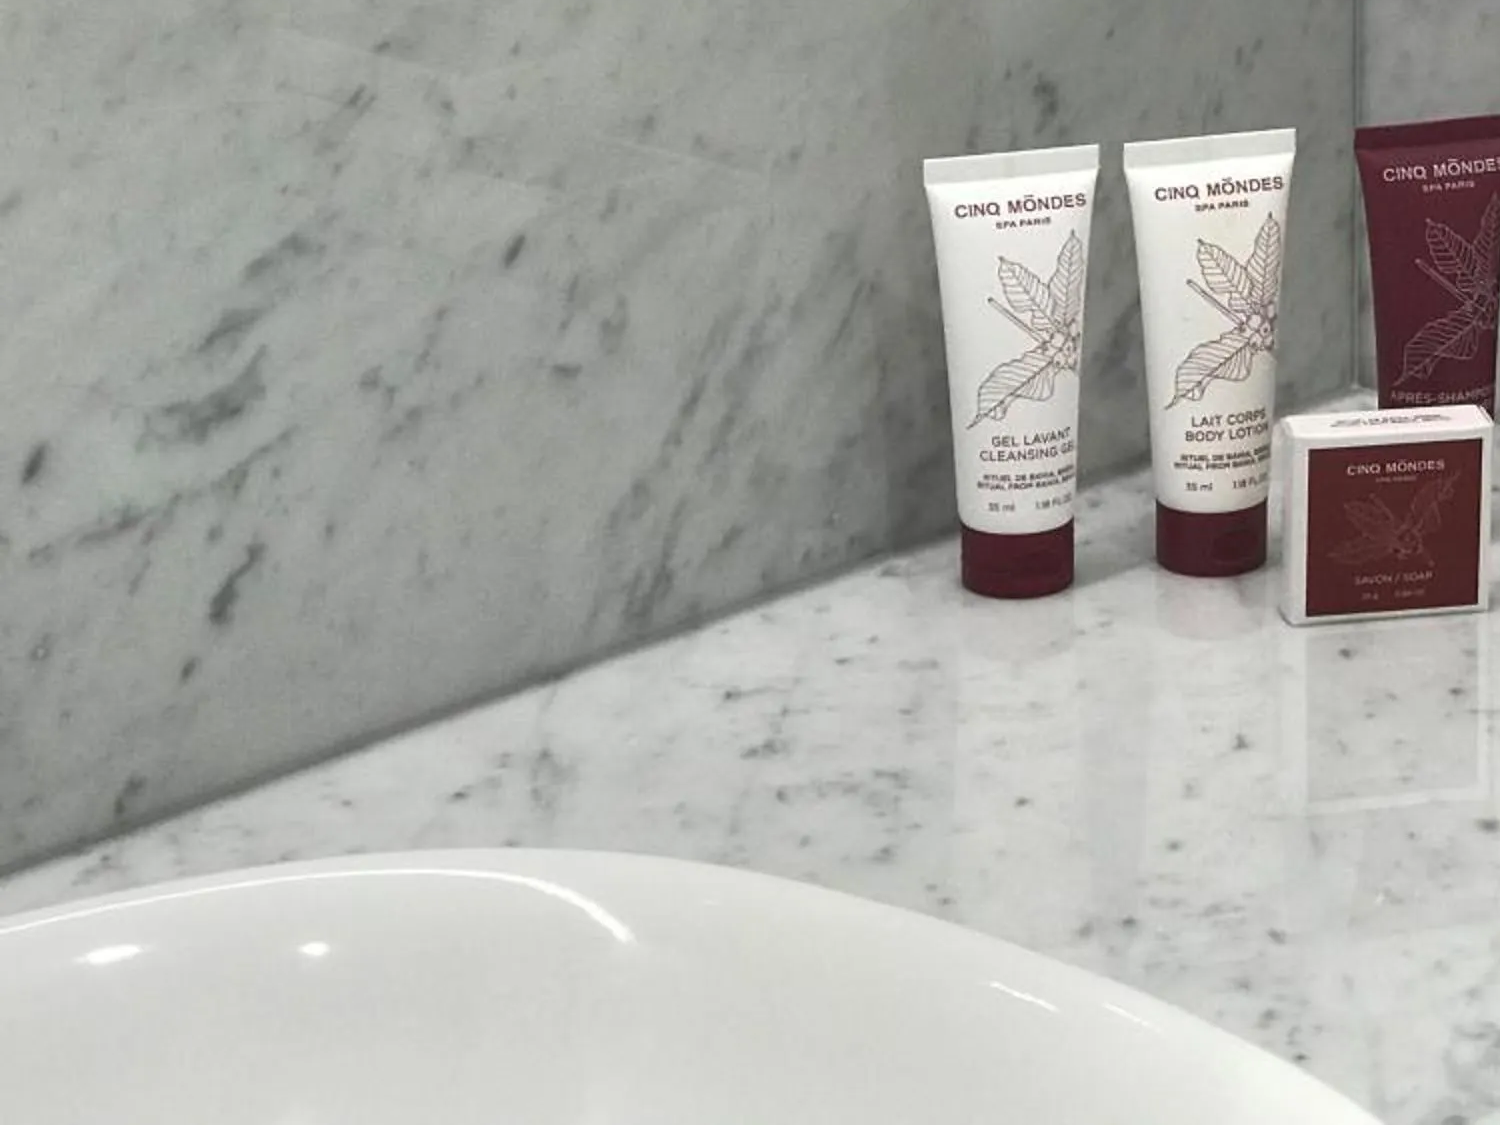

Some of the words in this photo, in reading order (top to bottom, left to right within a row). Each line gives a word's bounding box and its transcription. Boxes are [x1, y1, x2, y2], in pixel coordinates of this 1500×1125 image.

[1383, 166, 1427, 182] CINQ
[1154, 184, 1201, 202] CINQ
[954, 202, 1001, 219] CINQ
[995, 220, 1017, 230] SPA
[1019, 216, 1052, 228] PARIS
[1191, 415, 1222, 428] LAIT
[1226, 407, 1266, 425] CORPS
[991, 435, 1019, 448] GEL
[1023, 426, 1071, 446] LAVANT
[1184, 430, 1225, 442] BODY
[979, 446, 1058, 462] CLEANSING
[1347, 463, 1381, 476] CINQ
